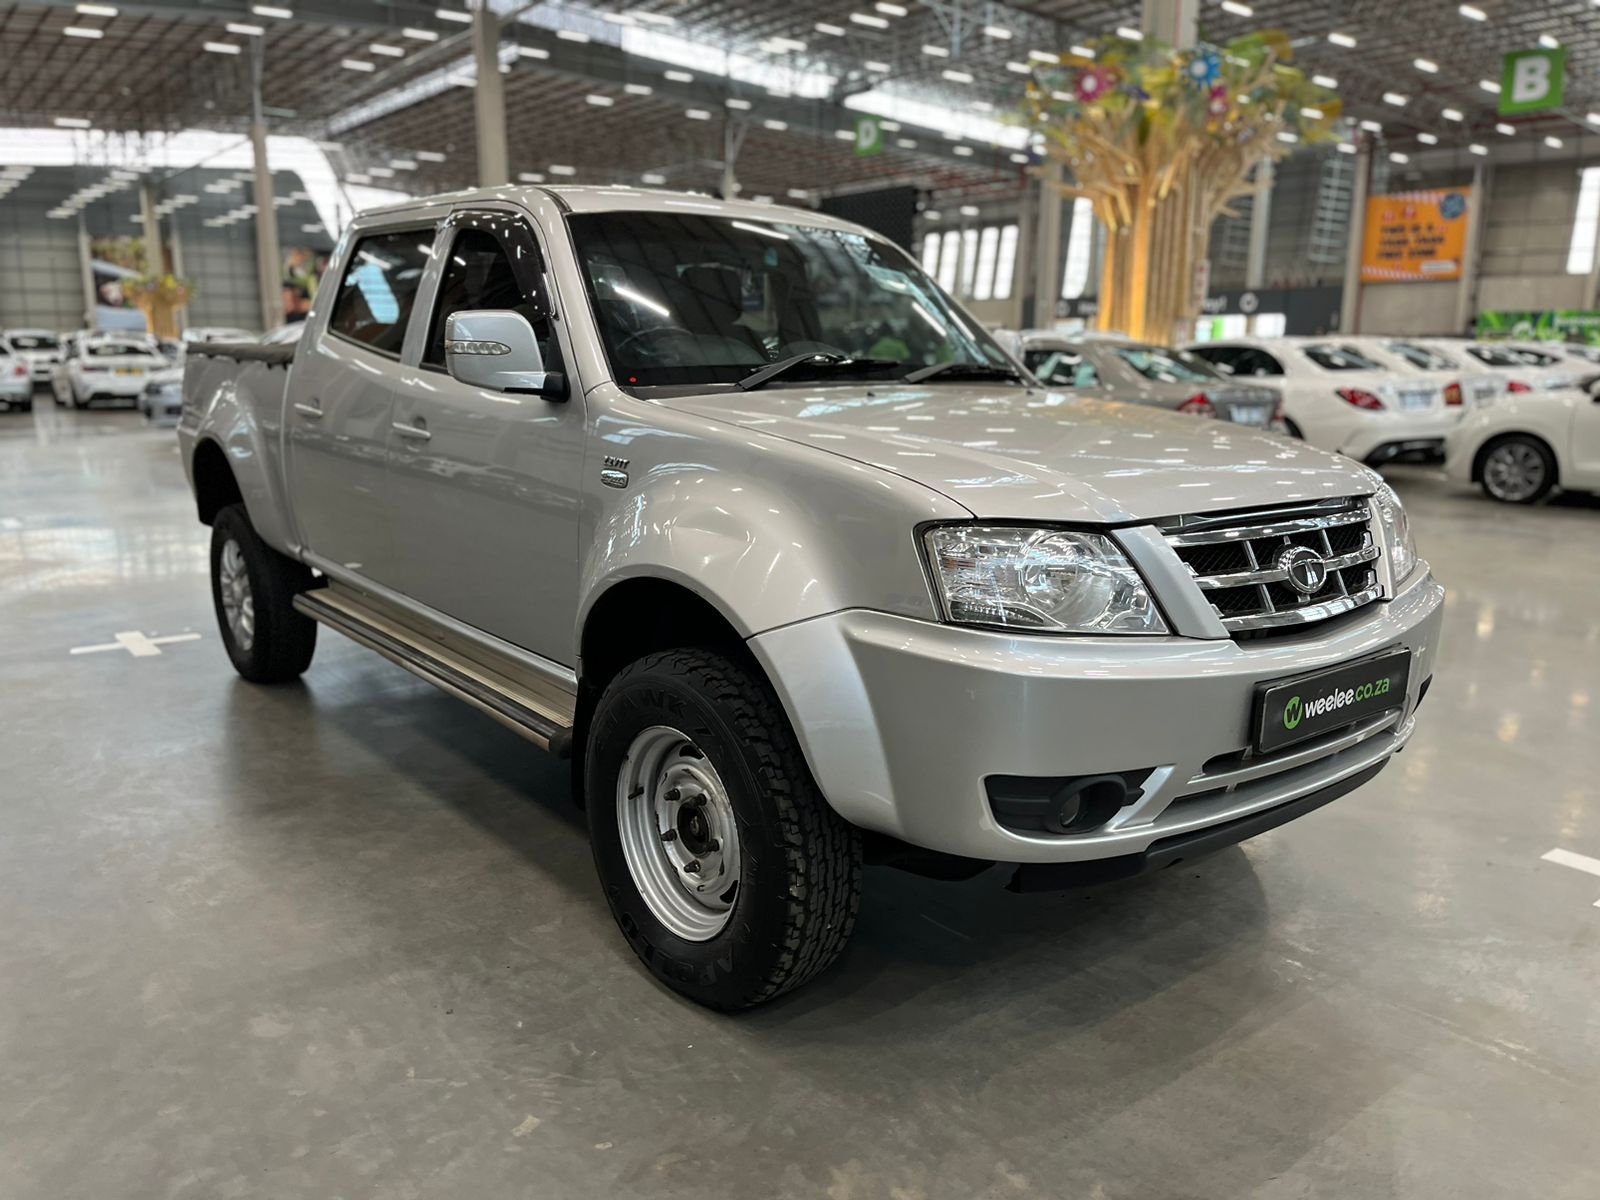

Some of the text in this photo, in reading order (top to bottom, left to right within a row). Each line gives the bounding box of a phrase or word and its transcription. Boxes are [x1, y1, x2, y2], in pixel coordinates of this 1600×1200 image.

[1512, 56, 1551, 103] B
[859, 119, 877, 149] D
[1305, 678, 1390, 719] weelee.co.za
